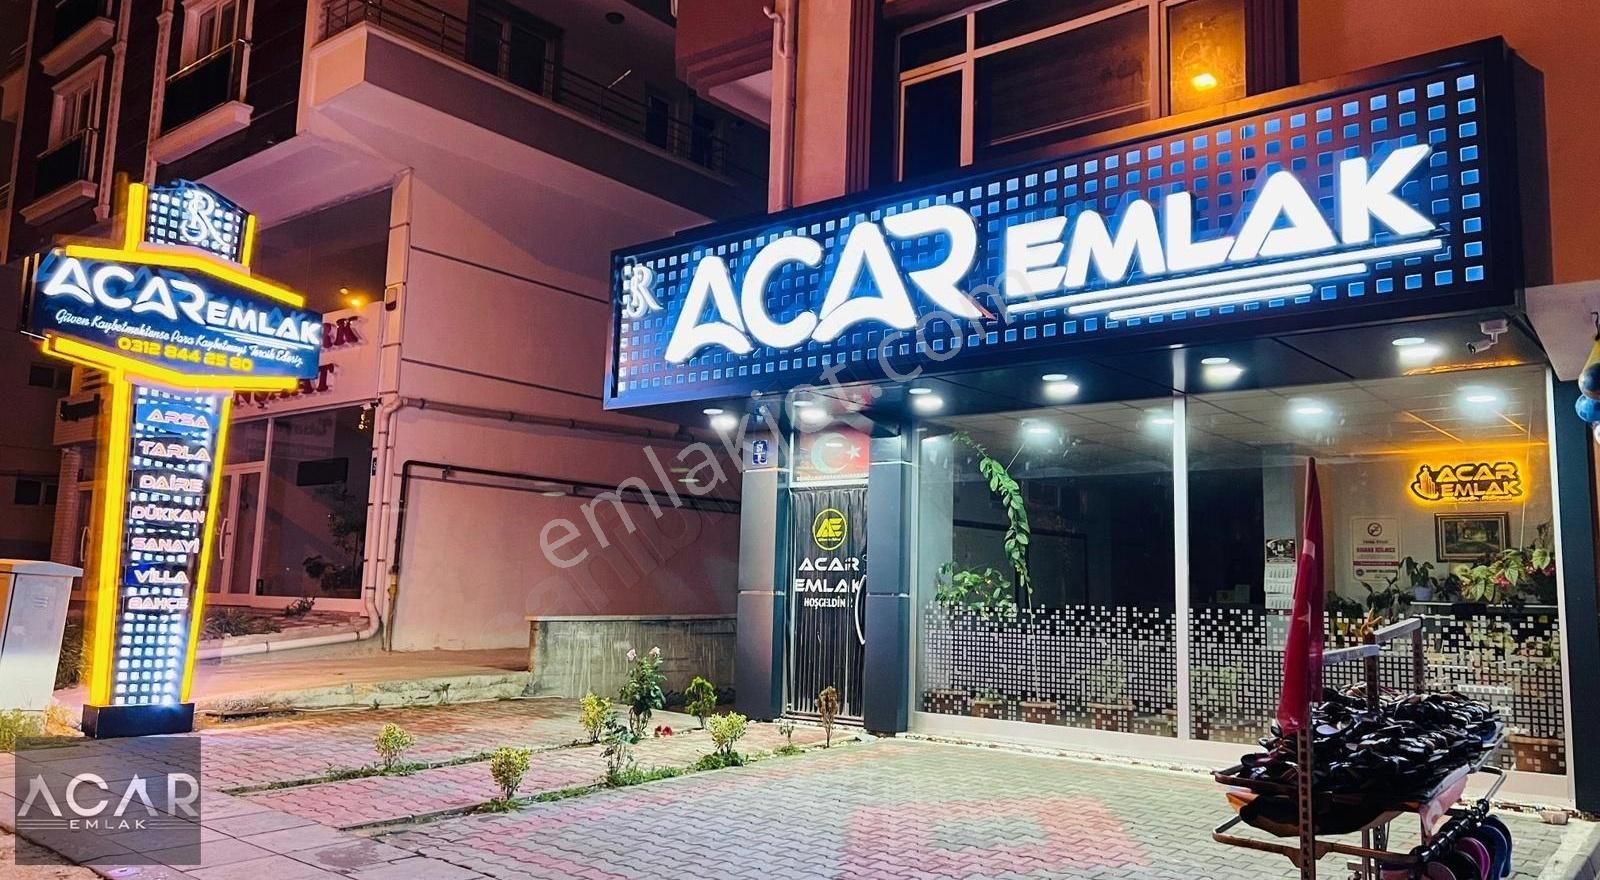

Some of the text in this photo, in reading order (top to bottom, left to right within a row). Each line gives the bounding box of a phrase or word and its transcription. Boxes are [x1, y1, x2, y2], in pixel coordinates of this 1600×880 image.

[664, 143, 1437, 364] ACAR EMLAK
[44, 257, 207, 325] ACAR
[206, 308, 322, 344] EMLAK
[170, 330, 195, 345] Para
[117, 336, 161, 356] 0312
[163, 344, 201, 363] 844
[146, 408, 209, 429] ARSA
[139, 440, 211, 462] TARLA
[1435, 464, 1517, 483] ACAR
[139, 474, 204, 493] DAİRE
[1441, 481, 1520, 498] EMLAK
[131, 505, 206, 524] DÜKKAN
[131, 536, 200, 554] SANAYİ
[798, 557, 860, 571] ACAR
[795, 579, 860, 593] EMLAK
[127, 596, 189, 613] BAHÇE
